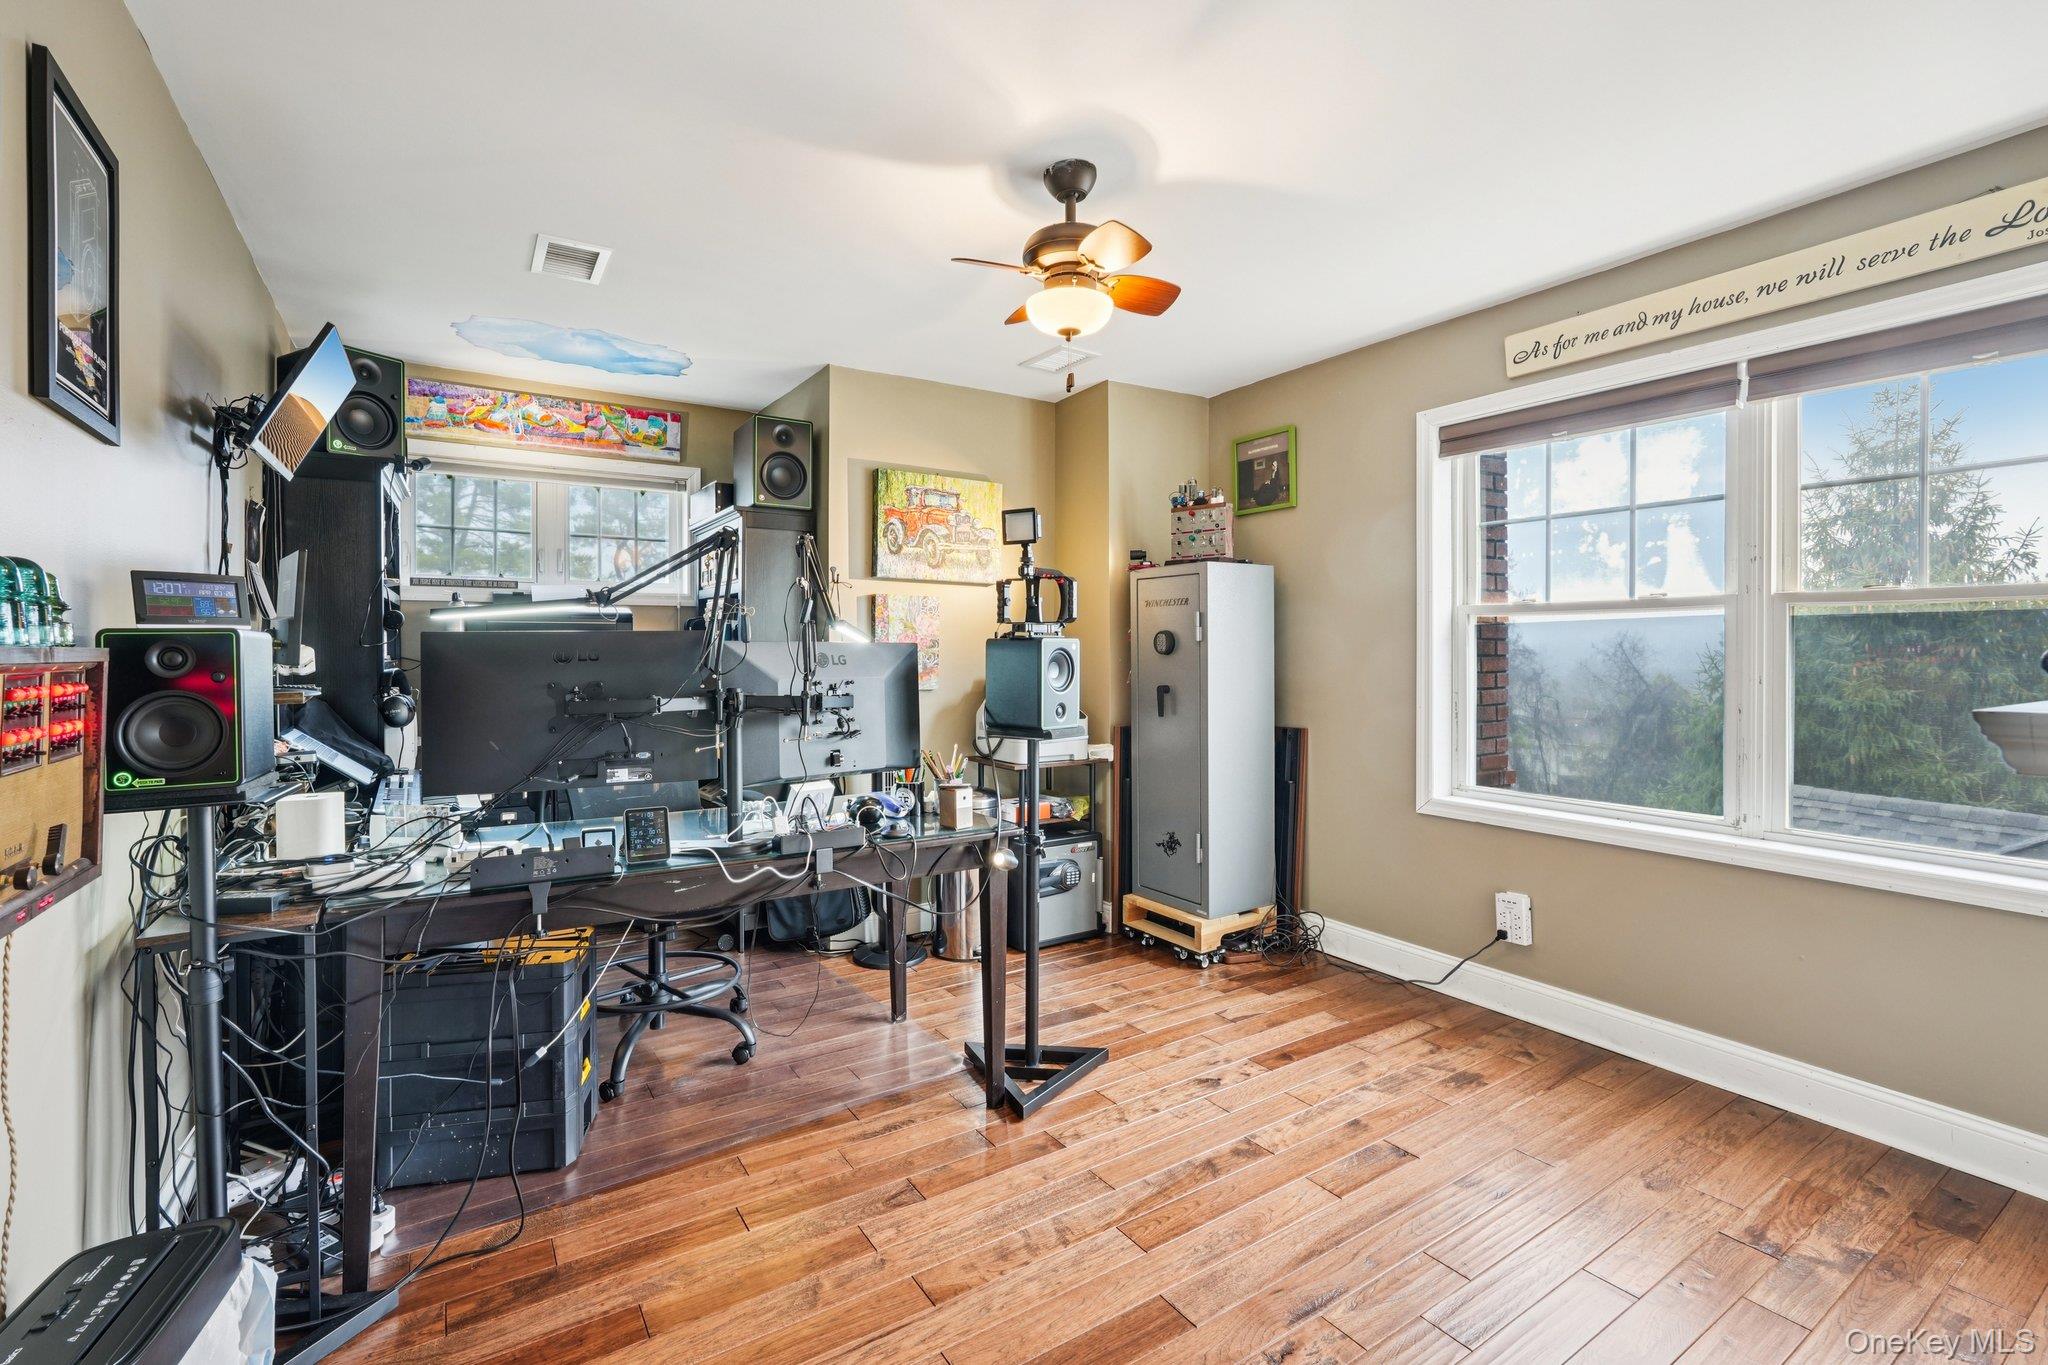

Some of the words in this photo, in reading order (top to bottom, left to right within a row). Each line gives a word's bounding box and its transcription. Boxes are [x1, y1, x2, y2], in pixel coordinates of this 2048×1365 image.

[1513, 340, 1549, 365] As
[1552, 334, 1579, 360] for
[1583, 328, 1610, 345] me
[1612, 311, 1649, 337] and
[1651, 308, 1684, 331] my
[1688, 290, 1749, 316] house,
[1756, 279, 1789, 298] we
[1796, 255, 1846, 286] will
[1856, 242, 1920, 271] serve
[1928, 224, 1972, 252] the
[1144, 597, 1190, 608] WINCHESTER
[830, 654, 847, 666] LG
